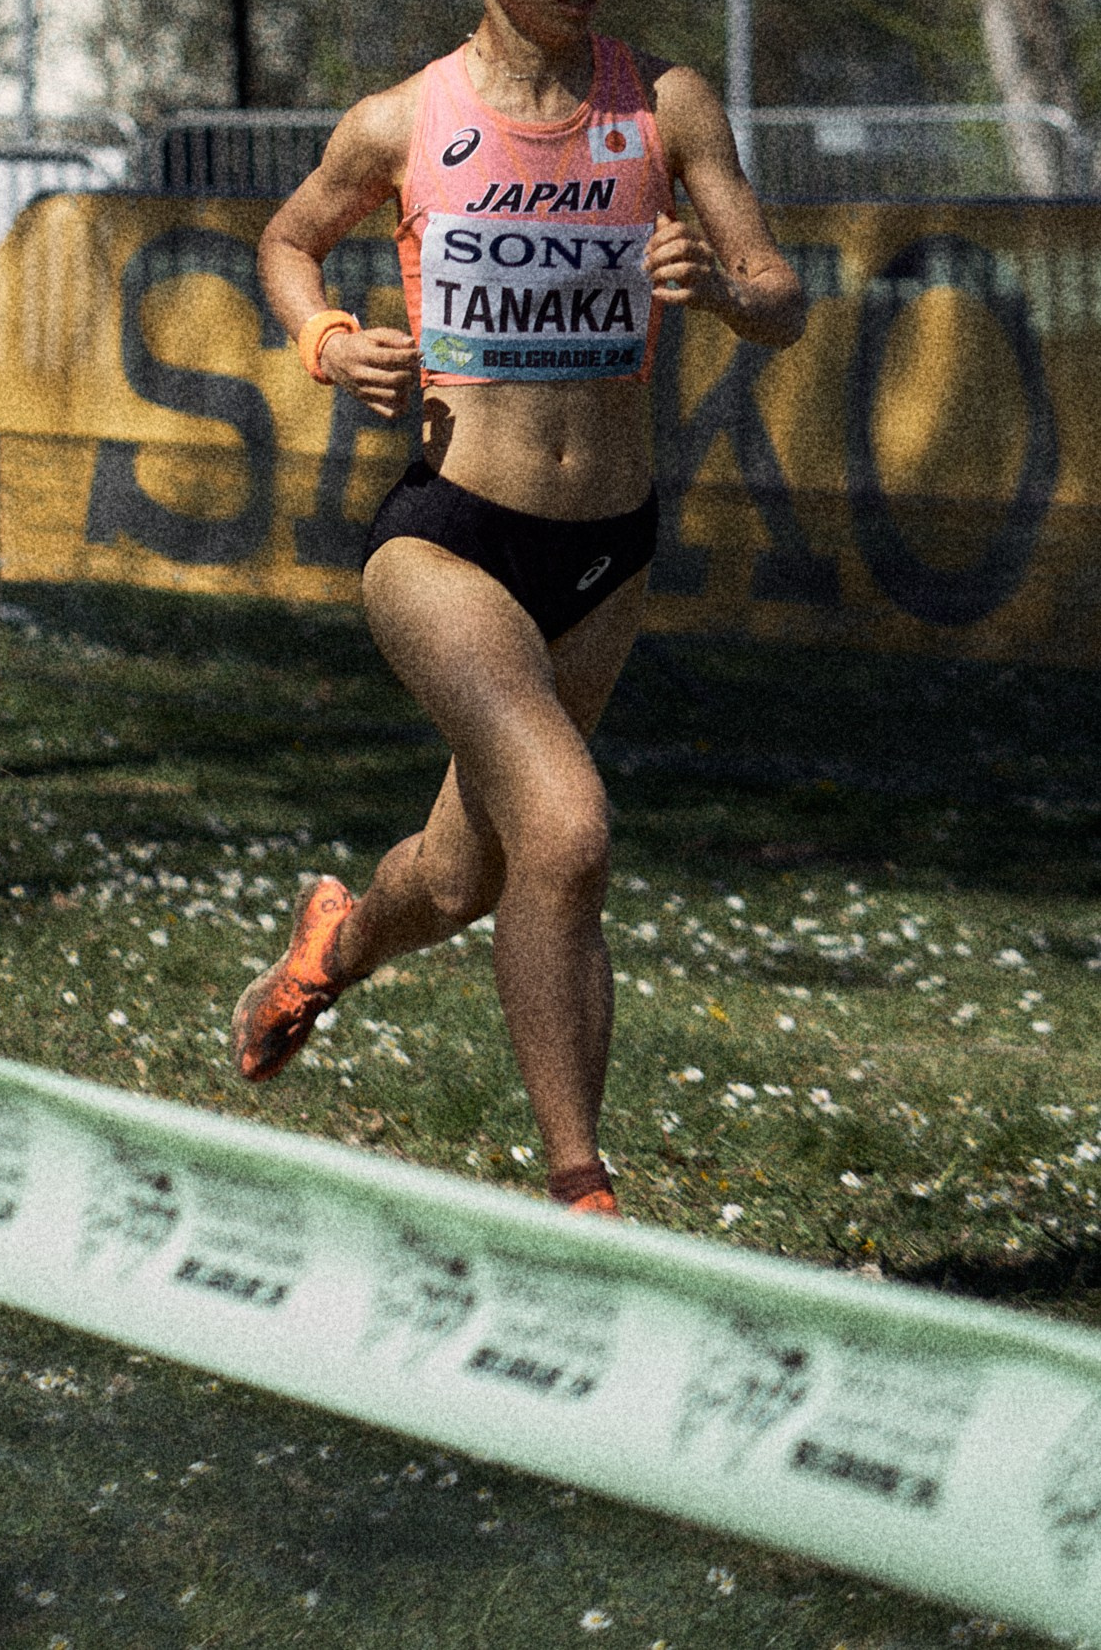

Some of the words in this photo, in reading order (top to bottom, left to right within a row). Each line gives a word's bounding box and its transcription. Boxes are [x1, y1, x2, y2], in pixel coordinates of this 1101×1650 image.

[465, 178, 617, 214] JAPAN
[444, 229, 635, 270] SONY
[435, 279, 635, 333] TANAKA
[482, 349, 601, 368] BELGRADE
[604, 348, 635, 367] 24
